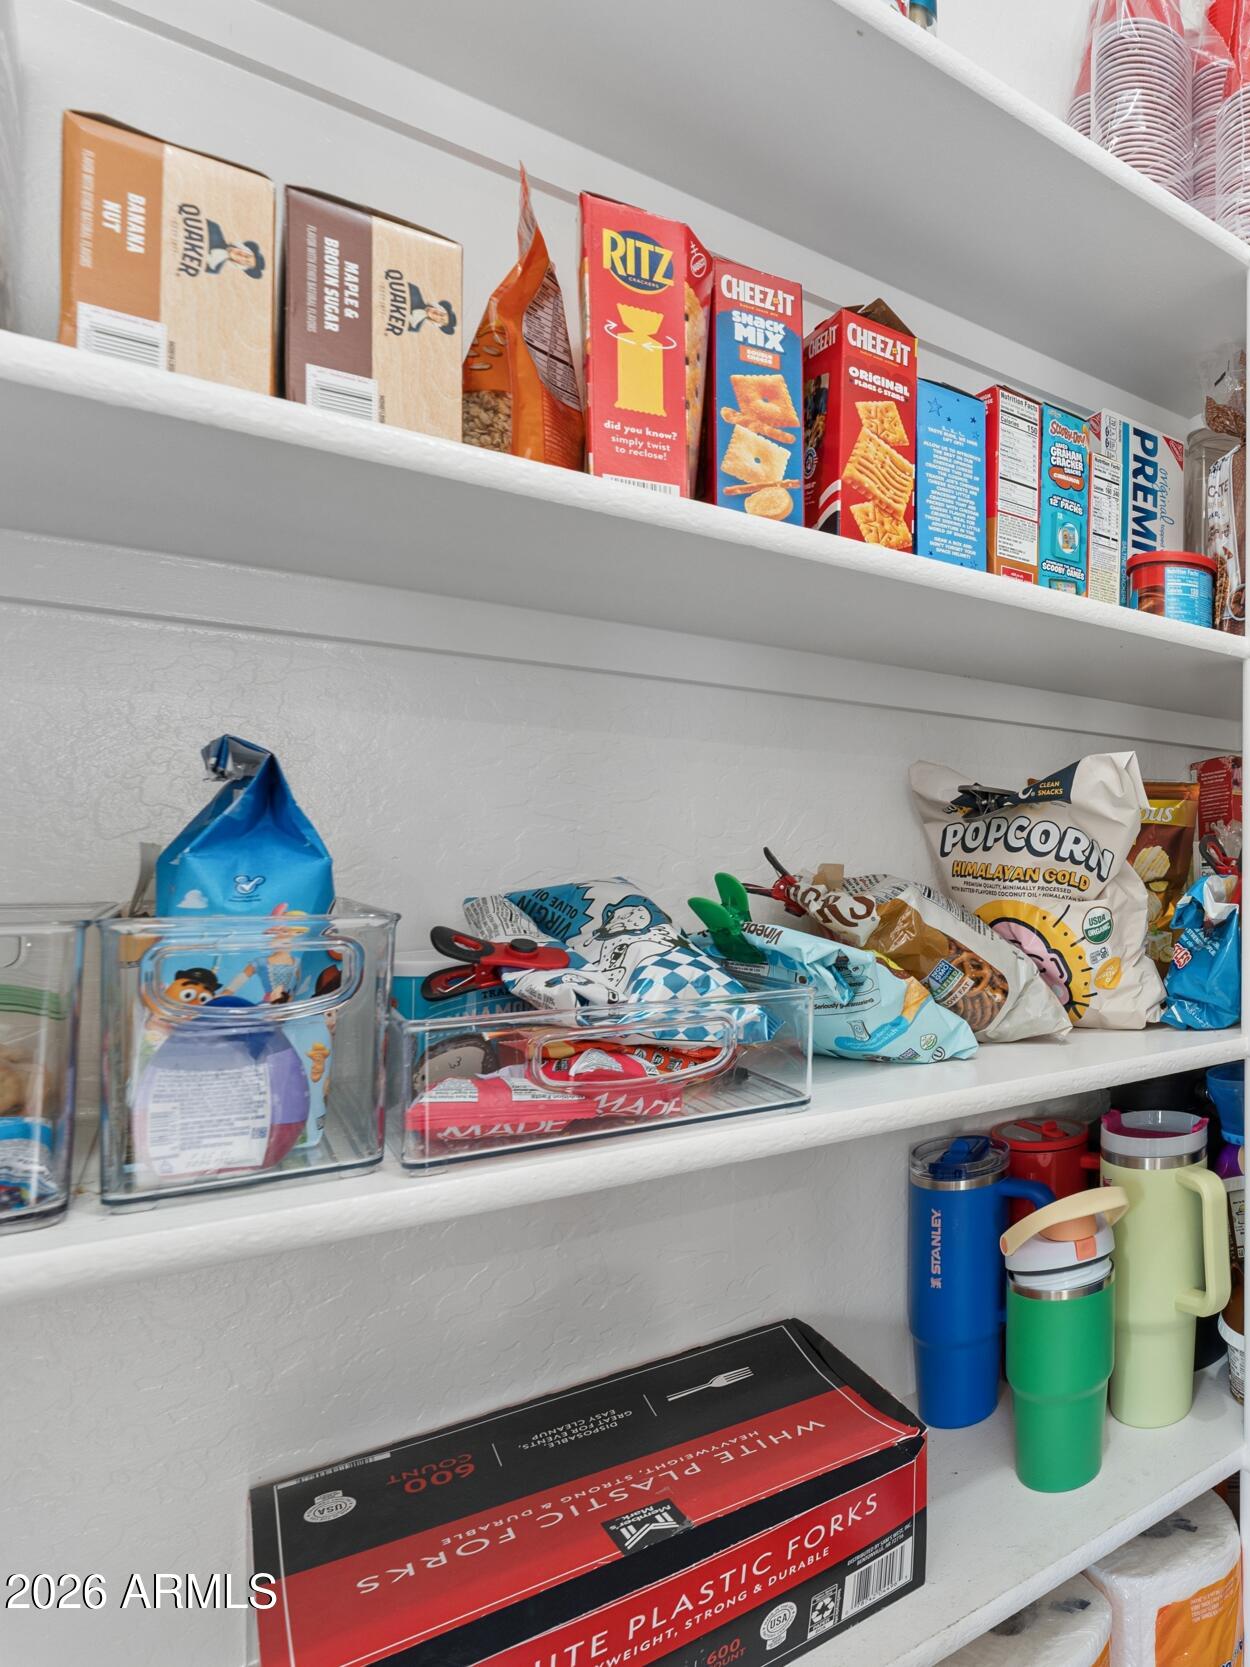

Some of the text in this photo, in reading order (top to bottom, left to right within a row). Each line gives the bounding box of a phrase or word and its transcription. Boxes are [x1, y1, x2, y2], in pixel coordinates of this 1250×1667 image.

[102, 199, 122, 233] NUT
[126, 192, 146, 254] BANANA
[178, 203, 205, 277] QUAKER
[602, 228, 675, 287] RITZ
[324, 236, 339, 333] BROWN SUGAR
[344, 260, 359, 319] MAPLE &
[628, 276, 660, 289] CRACKERS
[384, 269, 405, 336] QUAKER
[1001, 392, 1023, 406] Nutrition
[1025, 401, 1038, 412] Facts
[604, 420, 678, 440] did you know?
[611, 435, 671, 452] simply twist
[615, 446, 667, 460] to reclose!
[1051, 447, 1083, 461] GRAHAM
[1051, 457, 1083, 471] CRACKER
[1131, 427, 1159, 556] PREMI
[1060, 500, 1083, 515] PACKS
[1042, 562, 1065, 574] SCOOBY
[1037, 788, 1064, 796] SNACKS
[1039, 780, 1060, 788] CLEAN
[940, 815, 1115, 882] POPCORN
[951, 860, 1091, 892] HIMALAYAN GOLD
[1002, 884, 1036, 892] MINIMALLY
[1037, 886, 1072, 894] PROCESSED
[549, 894, 579, 920] OLIVE
[997, 889, 1026, 898] COCONUT
[515, 895, 574, 942] VIRGIN
[1087, 922, 1112, 938] ORGANIC
[1088, 915, 1106, 927] USDA
[930, 1208, 943, 1275] STANLEY
[518, 1410, 633, 1450] GREAT FOR EVENTS,
[531, 1408, 617, 1441] EASY CLEANUP
[548, 1421, 619, 1449] DISPOSABLE,
[386, 1453, 473, 1486] COUNT
[403, 1462, 476, 1495] 600
[440, 1429, 760, 1546] HEAVYWEIGHT, STRONG & DURABLE
[317, 1503, 345, 1517] USA
[356, 1419, 826, 1595] WHITE PLASTIC FORKS
[609, 1504, 672, 1531] Member's
[628, 1493, 879, 1640] PLASTIC FORKS
[684, 1546, 831, 1631] STRONG & DURABLE
[769, 1613, 789, 1630] USA
[706, 1637, 742, 1666] 600
